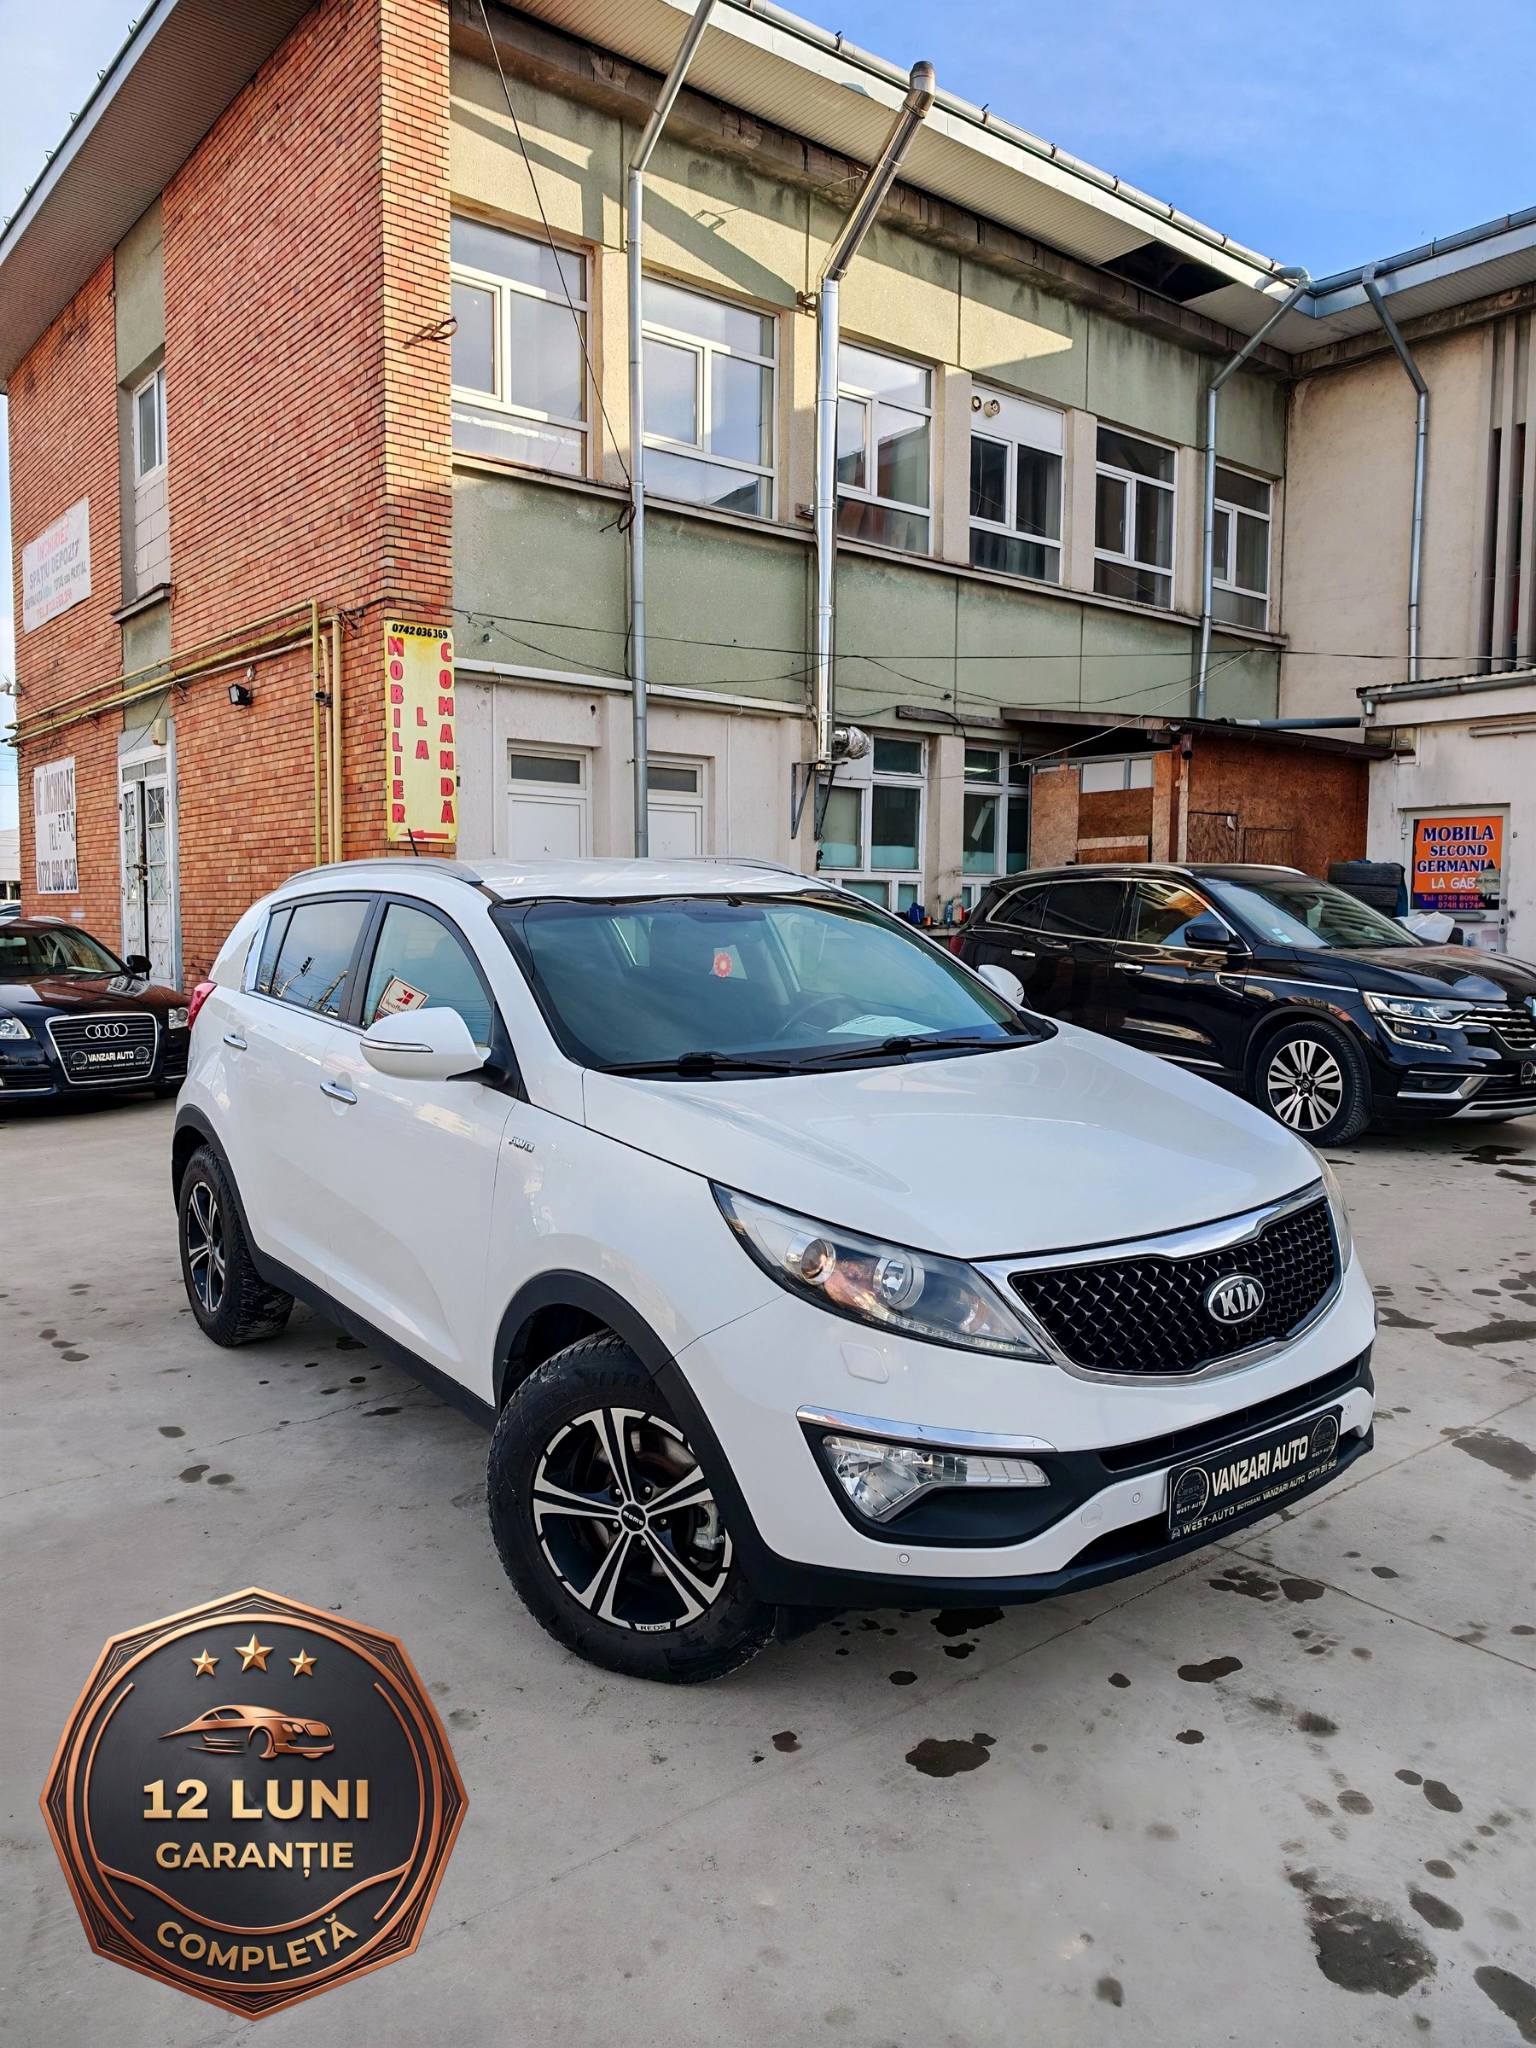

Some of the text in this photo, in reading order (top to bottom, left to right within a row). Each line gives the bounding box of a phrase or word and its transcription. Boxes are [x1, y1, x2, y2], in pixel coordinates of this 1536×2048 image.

[392, 623, 448, 639] 0742 036 369
[1423, 825, 1494, 841] MOBILA
[1430, 844, 1488, 856] SECOND
[1432, 878, 1444, 889] LA
[88, 1050, 134, 1063] VANZARI AUTO
[1219, 1283, 1260, 1317] KIA
[1212, 1435, 1308, 1497] VANZARI AUTO
[1183, 1506, 1235, 1534] WEST-AUTO
[1263, 1483, 1288, 1500] VANZARI
[1289, 1475, 1306, 1489] AUTO
